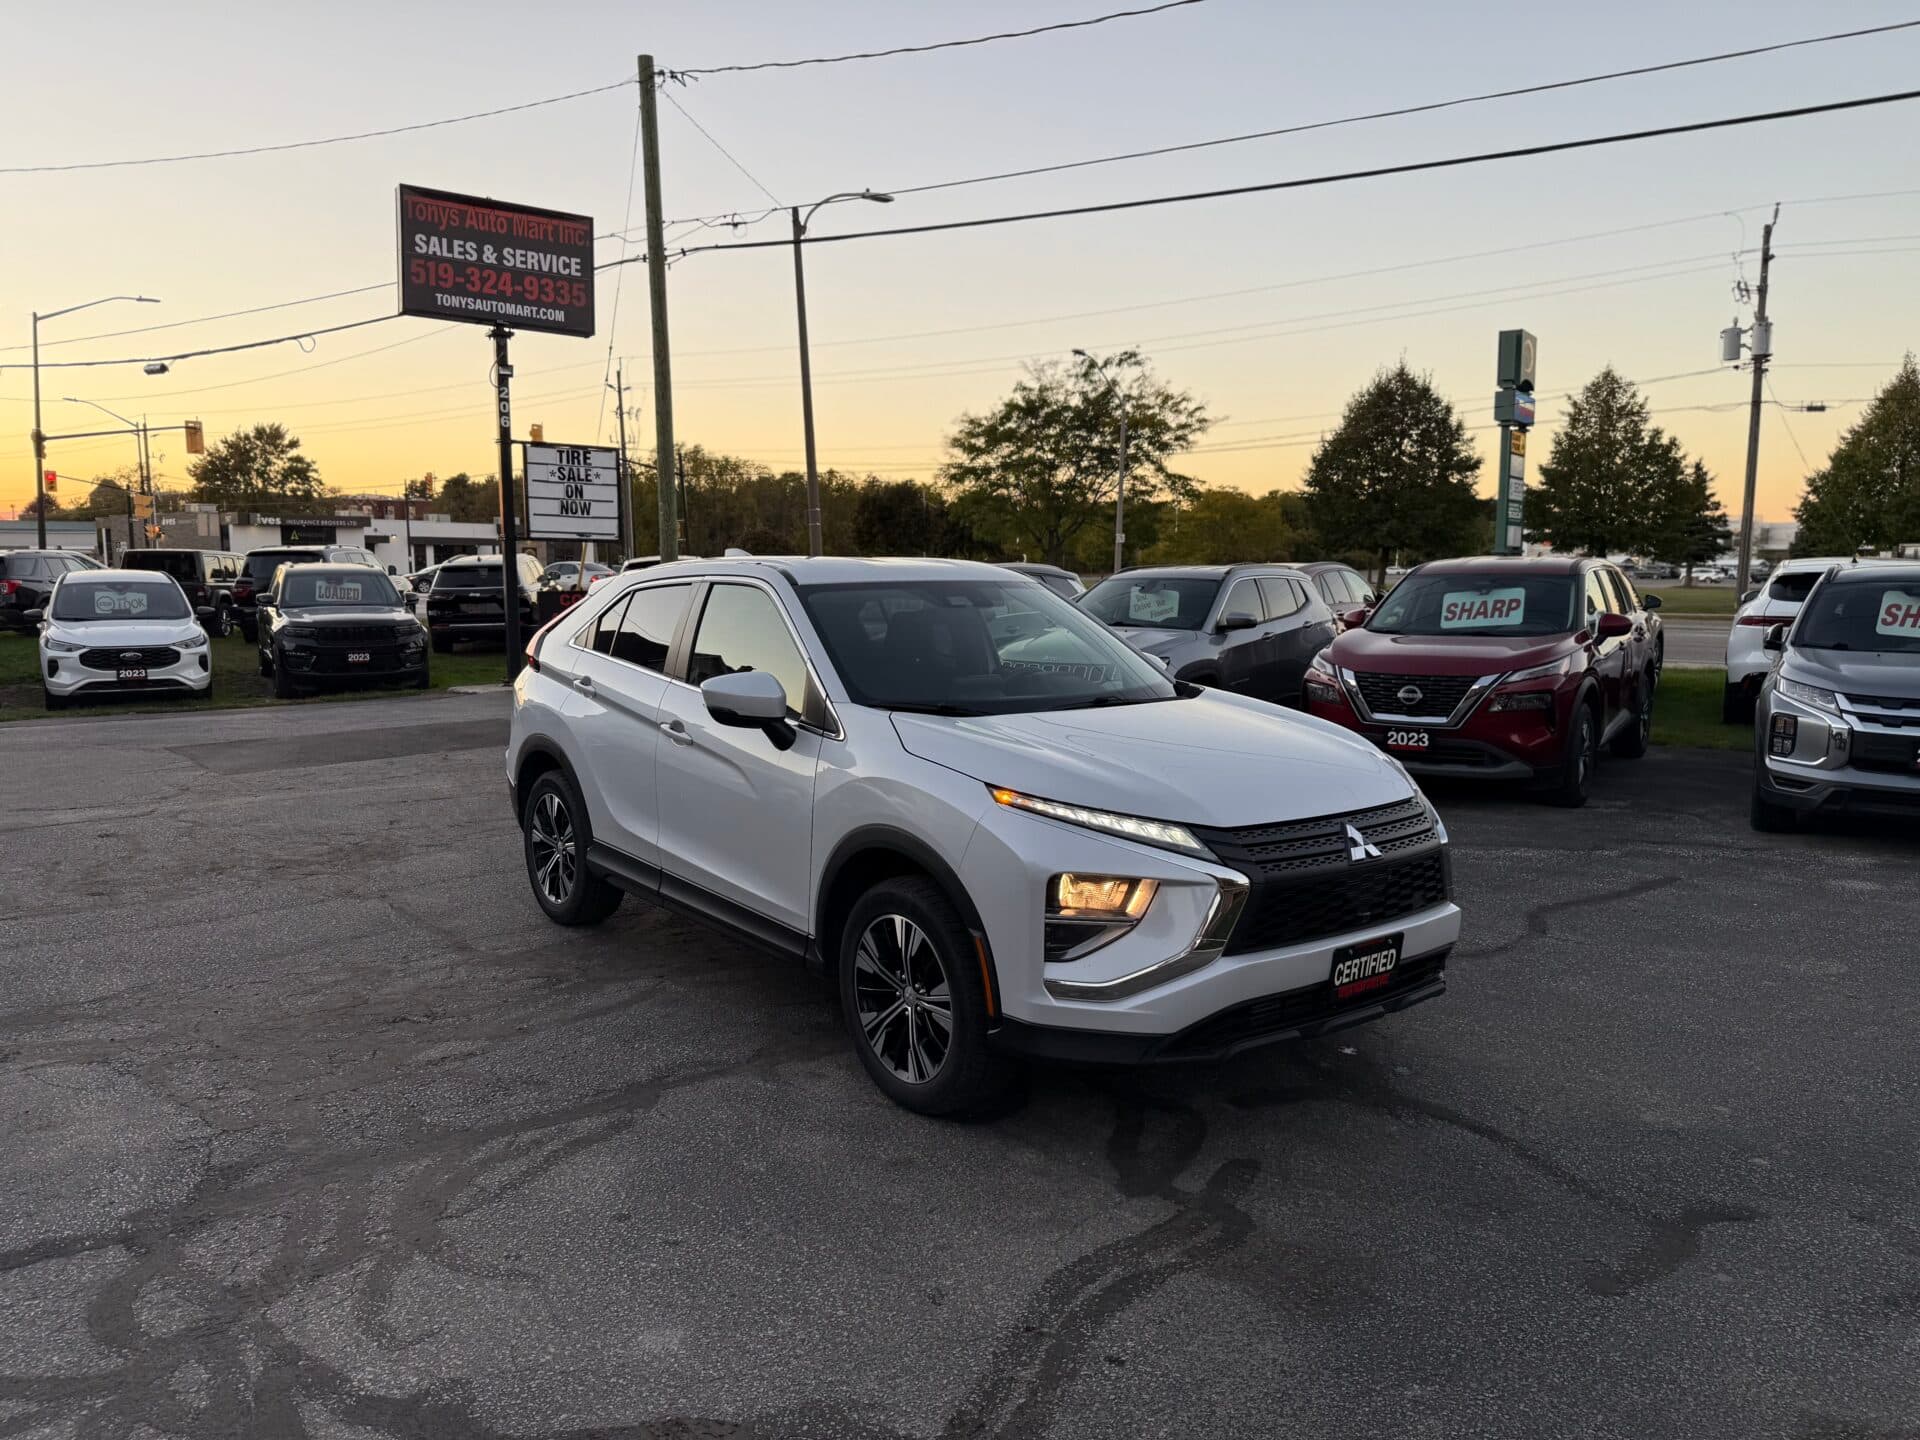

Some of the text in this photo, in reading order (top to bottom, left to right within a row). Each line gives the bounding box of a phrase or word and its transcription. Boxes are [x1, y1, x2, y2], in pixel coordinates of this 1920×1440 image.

[406, 197, 590, 246] Tonys Auto Mart Inc.
[414, 233, 582, 277] SALES & SERVICE
[410, 258, 587, 308] 519-324-9335
[434, 292, 565, 323] TONYSAUTOMART.COM
[557, 450, 592, 466] TIRE
[565, 484, 583, 499] ON
[560, 501, 591, 516] NOW
[1443, 598, 1521, 622] SHARP
[1880, 603, 1920, 629] SH
[348, 653, 370, 662] 2023
[119, 669, 146, 678] 2023
[1387, 731, 1430, 747] 2023
[1334, 948, 1397, 987] CERTIFIED
